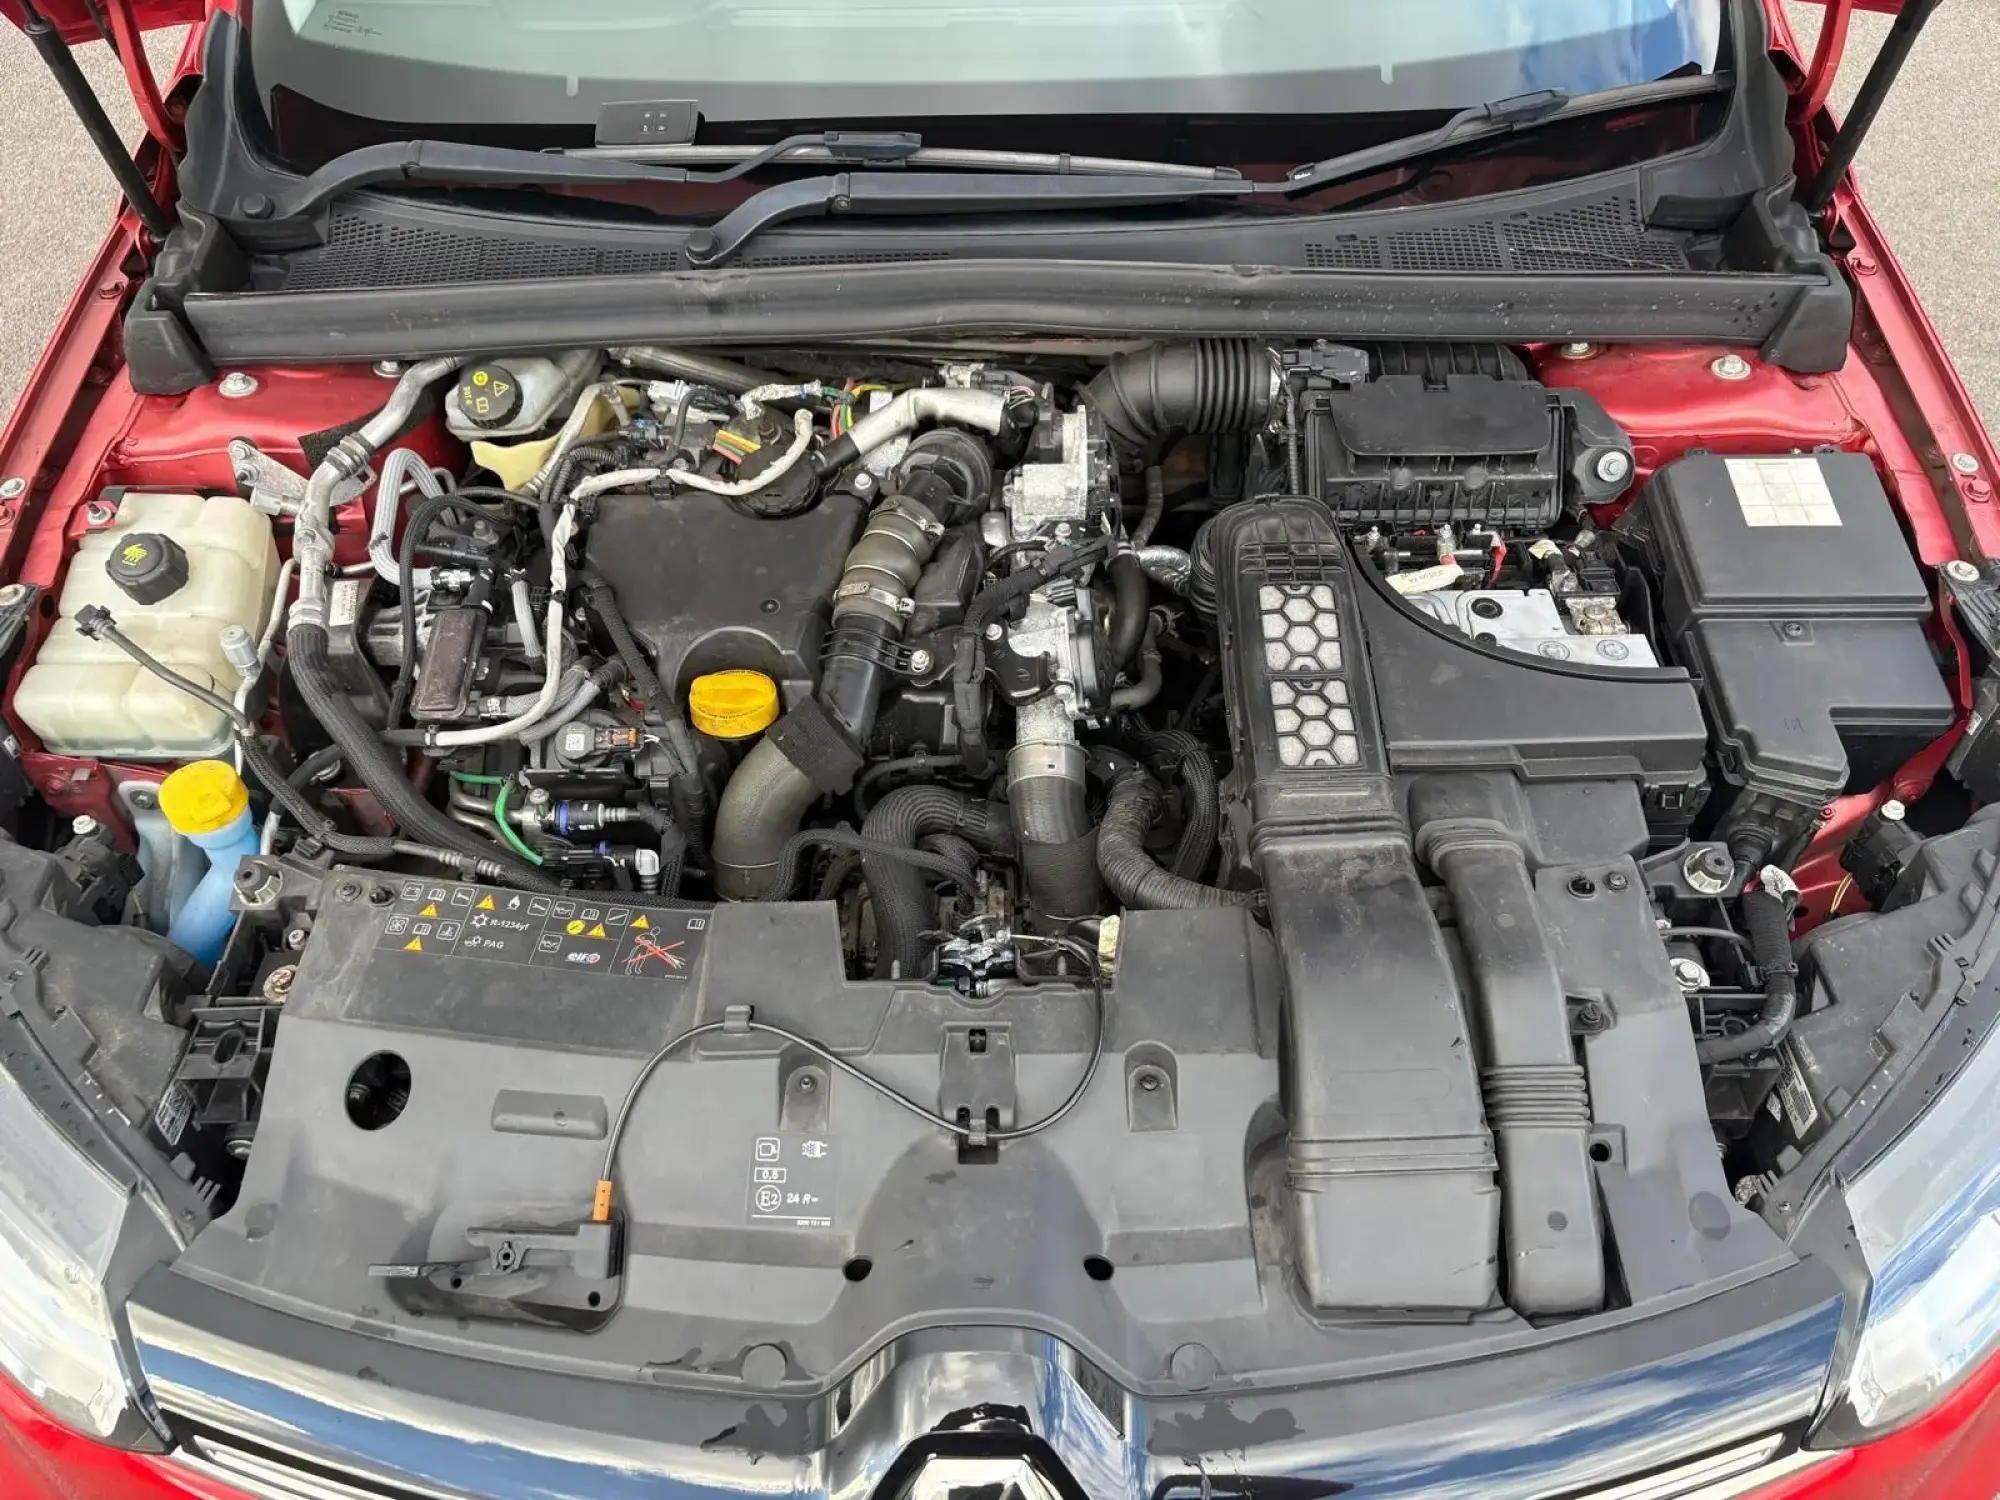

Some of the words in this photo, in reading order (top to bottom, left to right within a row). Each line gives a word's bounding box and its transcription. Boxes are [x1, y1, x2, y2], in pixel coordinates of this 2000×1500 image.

[490, 919, 530, 931] R-1234yf
[483, 939, 505, 949] PAG
[760, 1190, 778, 1207] E2
[786, 1192, 800, 1204] 24
